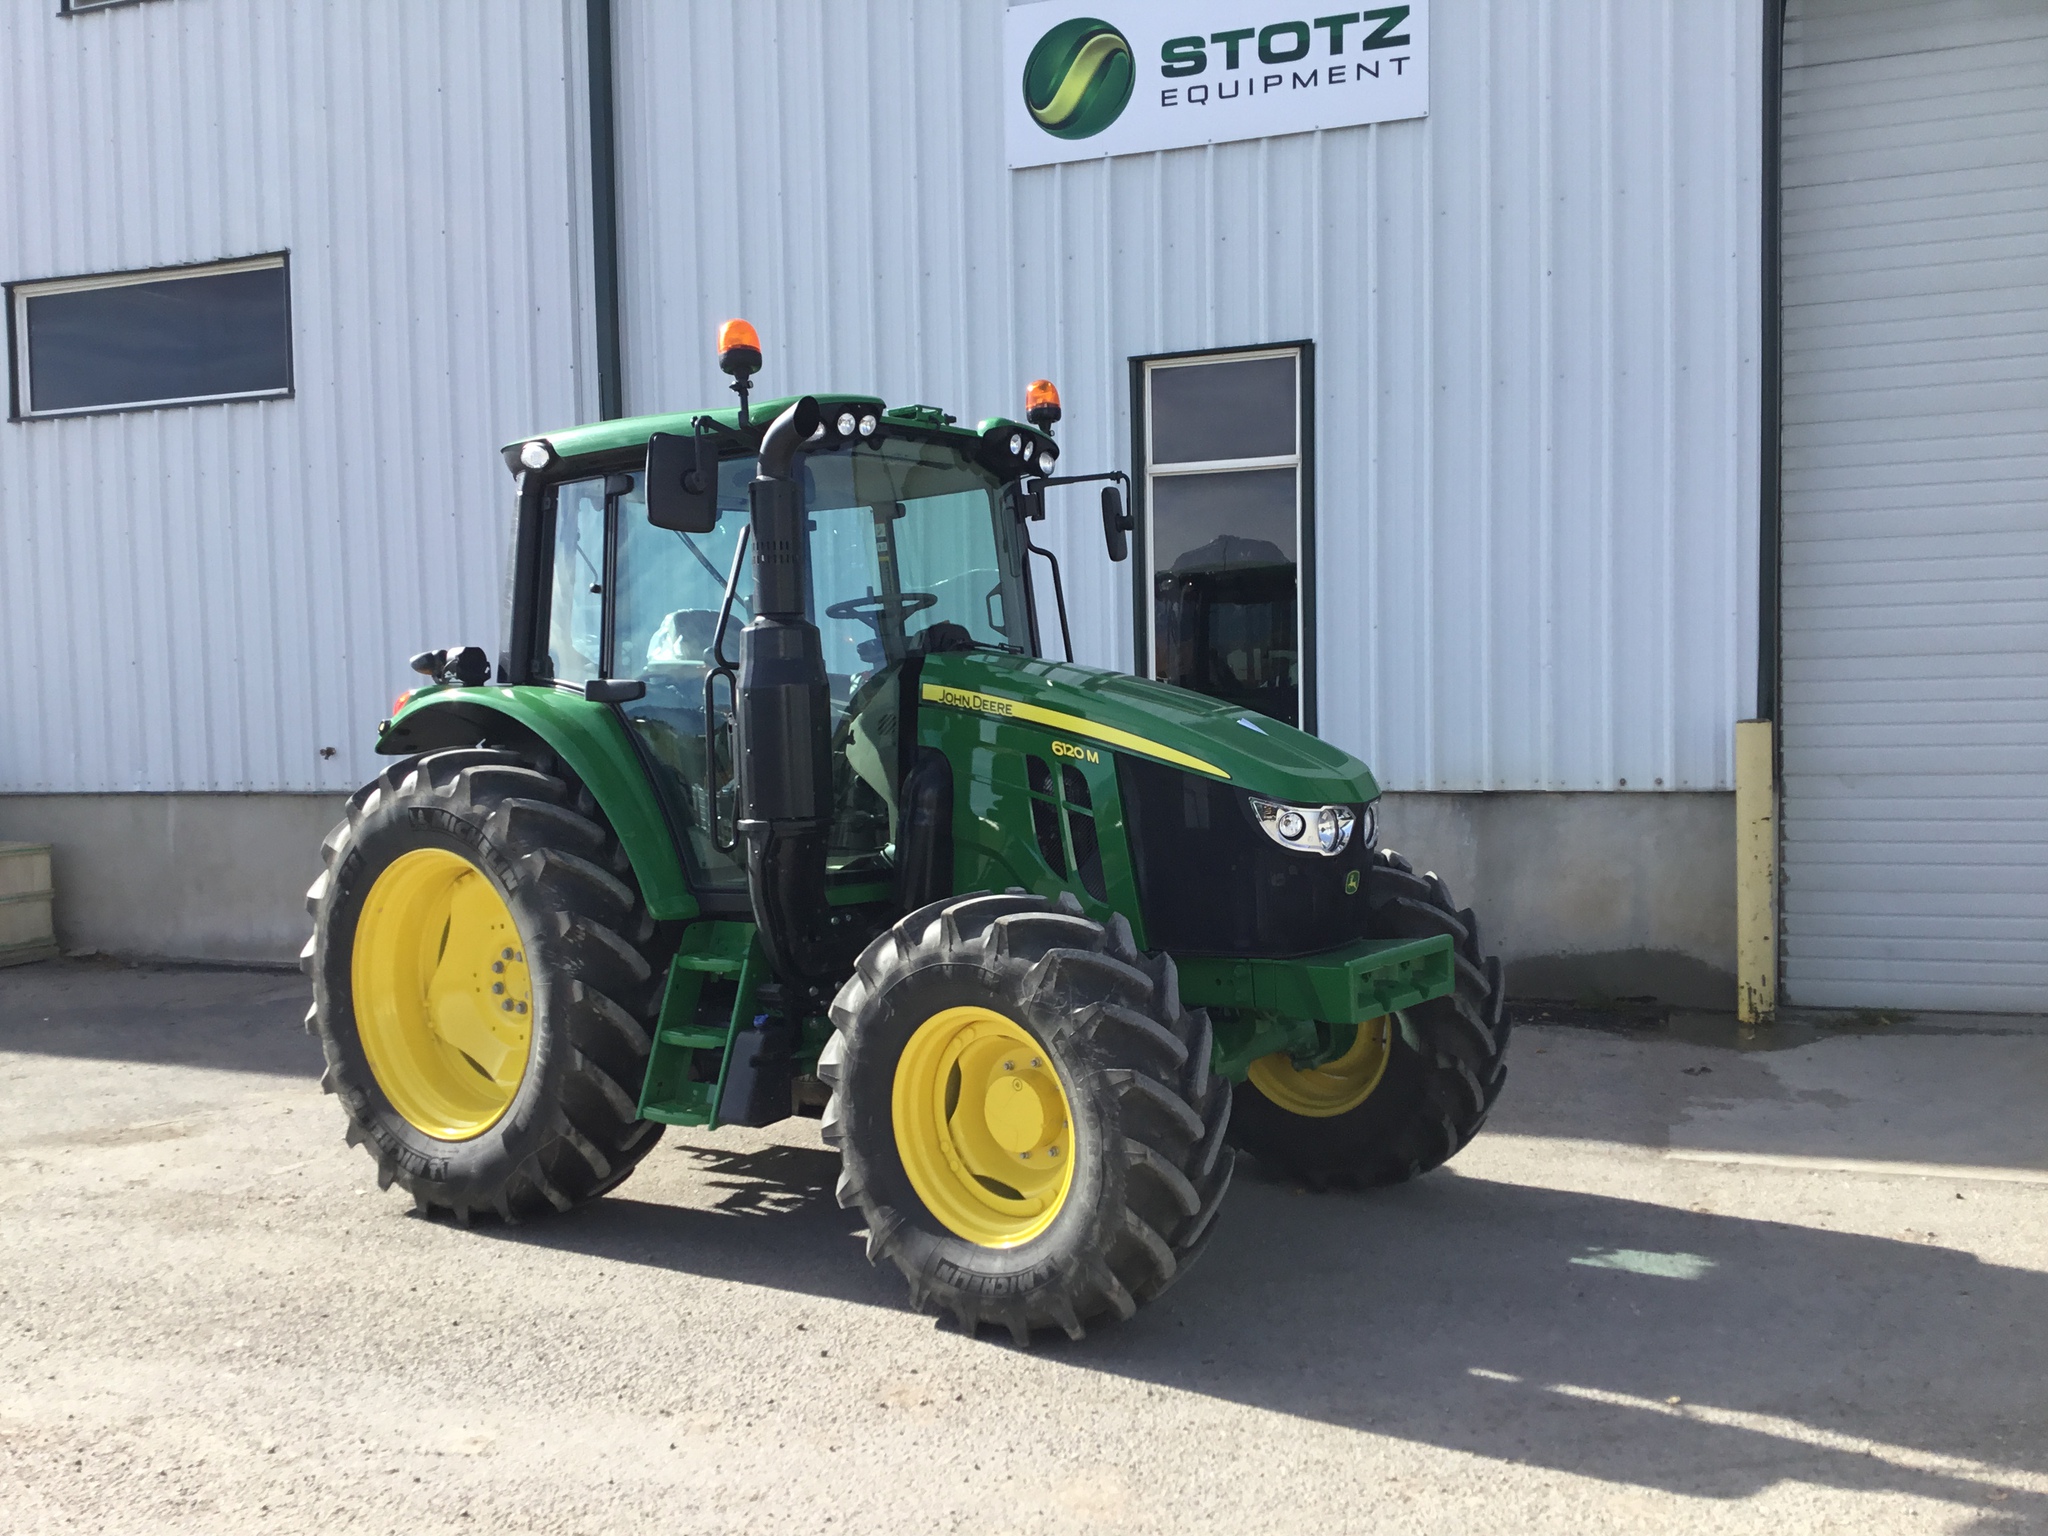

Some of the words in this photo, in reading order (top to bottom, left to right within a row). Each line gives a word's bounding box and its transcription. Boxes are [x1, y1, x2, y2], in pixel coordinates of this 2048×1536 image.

[1161, 5, 1411, 79] STOTZ
[1161, 56, 1411, 107] EQUIPMENT
[938, 689, 970, 708] JOHN
[972, 695, 1013, 716] DEERE
[432, 808, 519, 892] MICHELIN
[935, 1262, 1035, 1295] MICHELIN
